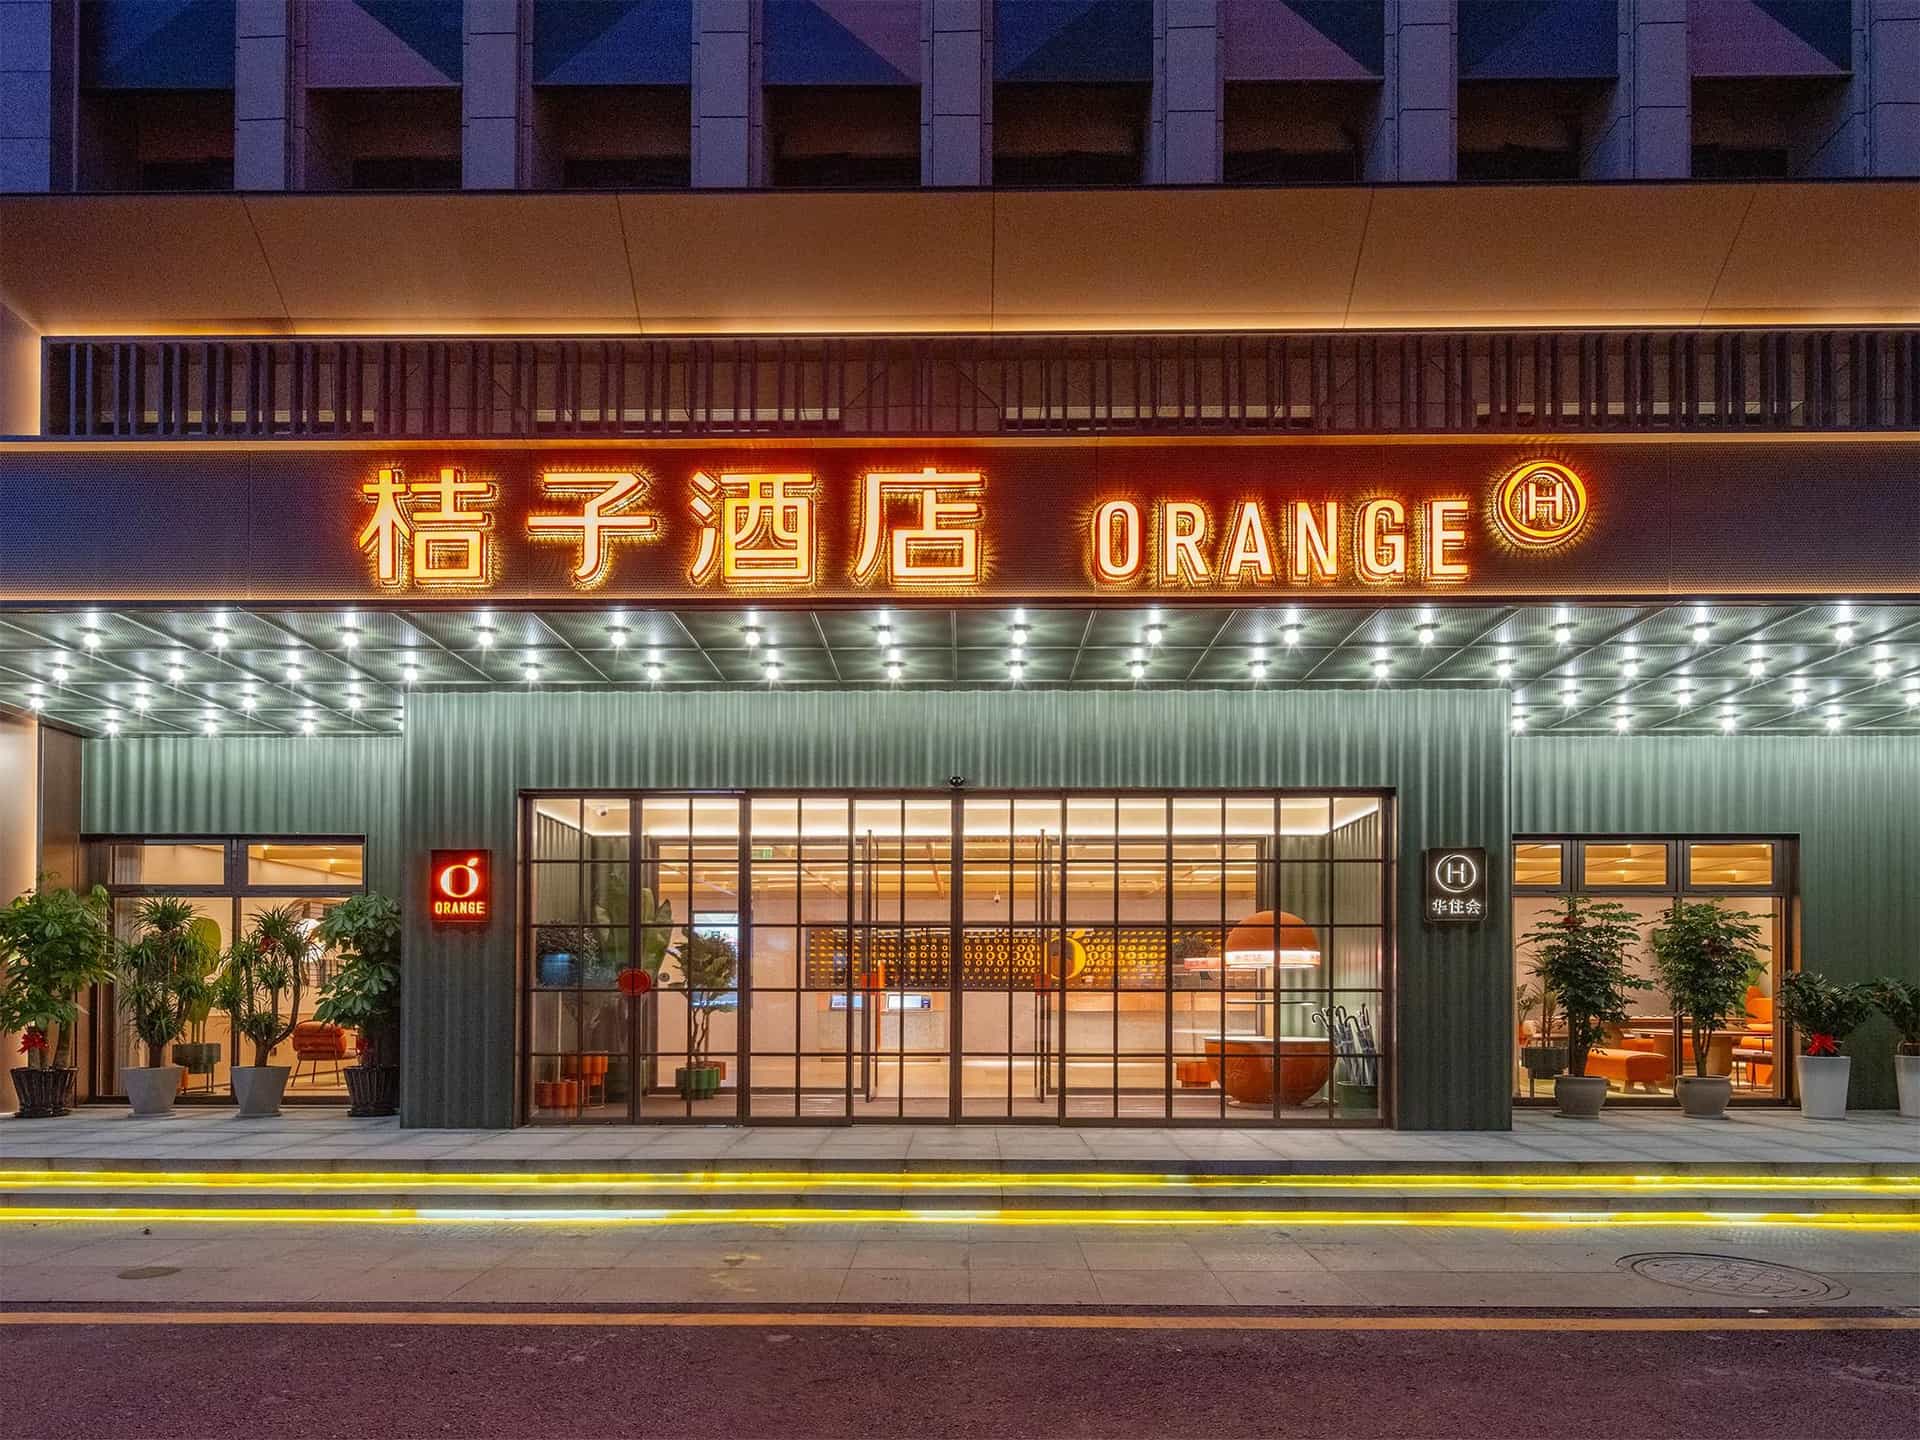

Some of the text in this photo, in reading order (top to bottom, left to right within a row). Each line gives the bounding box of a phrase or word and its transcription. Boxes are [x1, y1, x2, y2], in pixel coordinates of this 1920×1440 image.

[359, 467, 982, 586] 桔子酒店
[1097, 499, 1469, 578] ORANGE
[435, 901, 486, 915] ORANGE
[1432, 898, 1482, 915] 华住会
